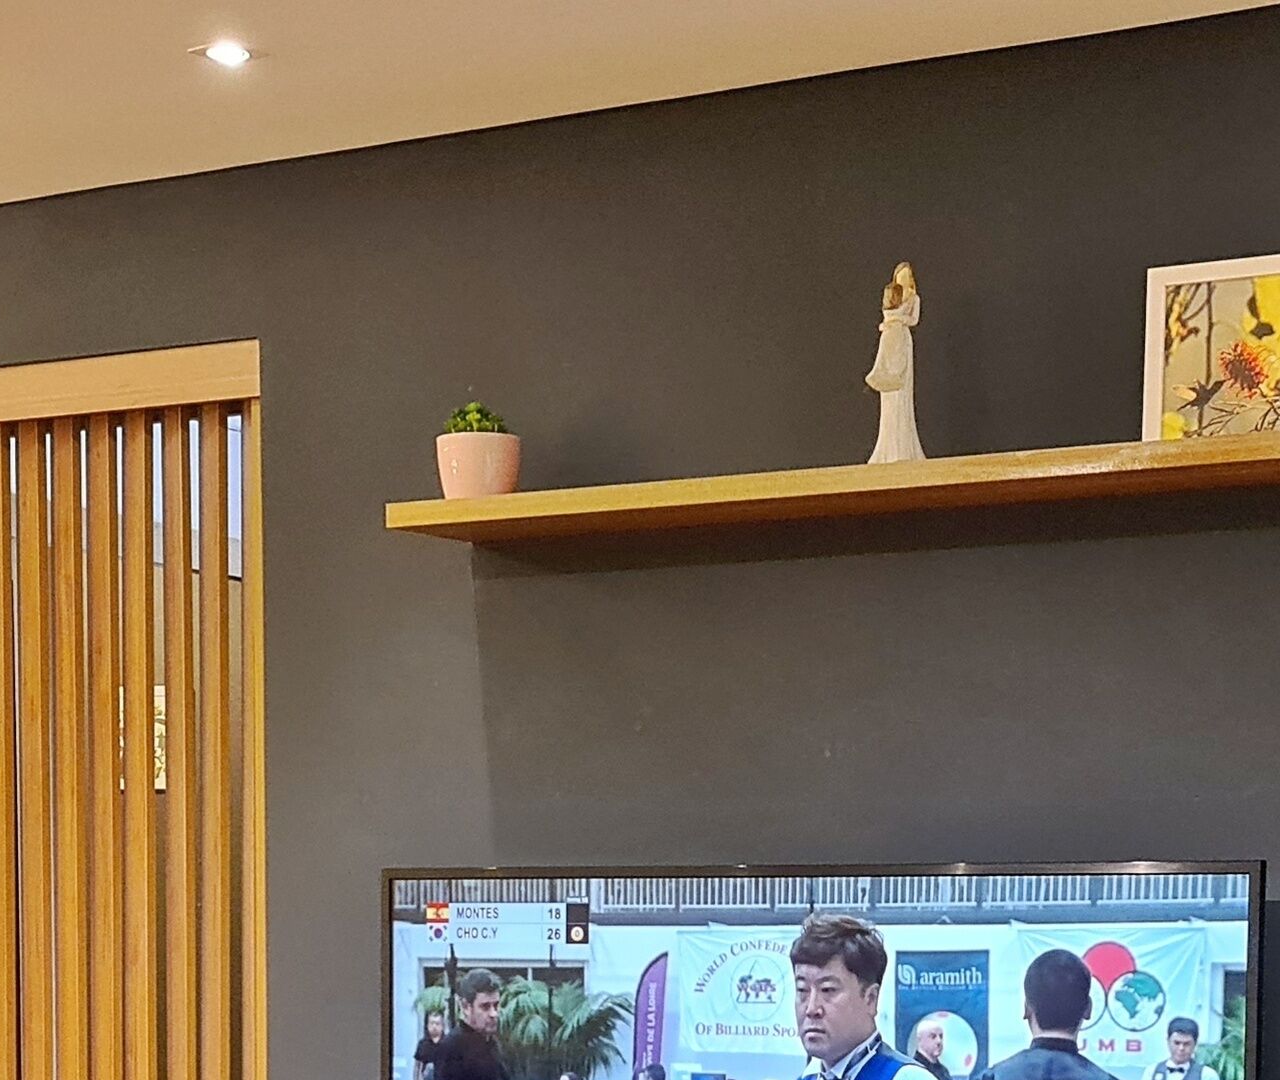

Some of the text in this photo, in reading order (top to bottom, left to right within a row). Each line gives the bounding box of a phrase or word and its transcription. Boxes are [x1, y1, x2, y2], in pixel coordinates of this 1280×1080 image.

[456, 907, 562, 920] MONTES 18
[456, 927, 481, 940] CHO
[546, 928, 562, 941] 26
[919, 966, 983, 986] aramith
